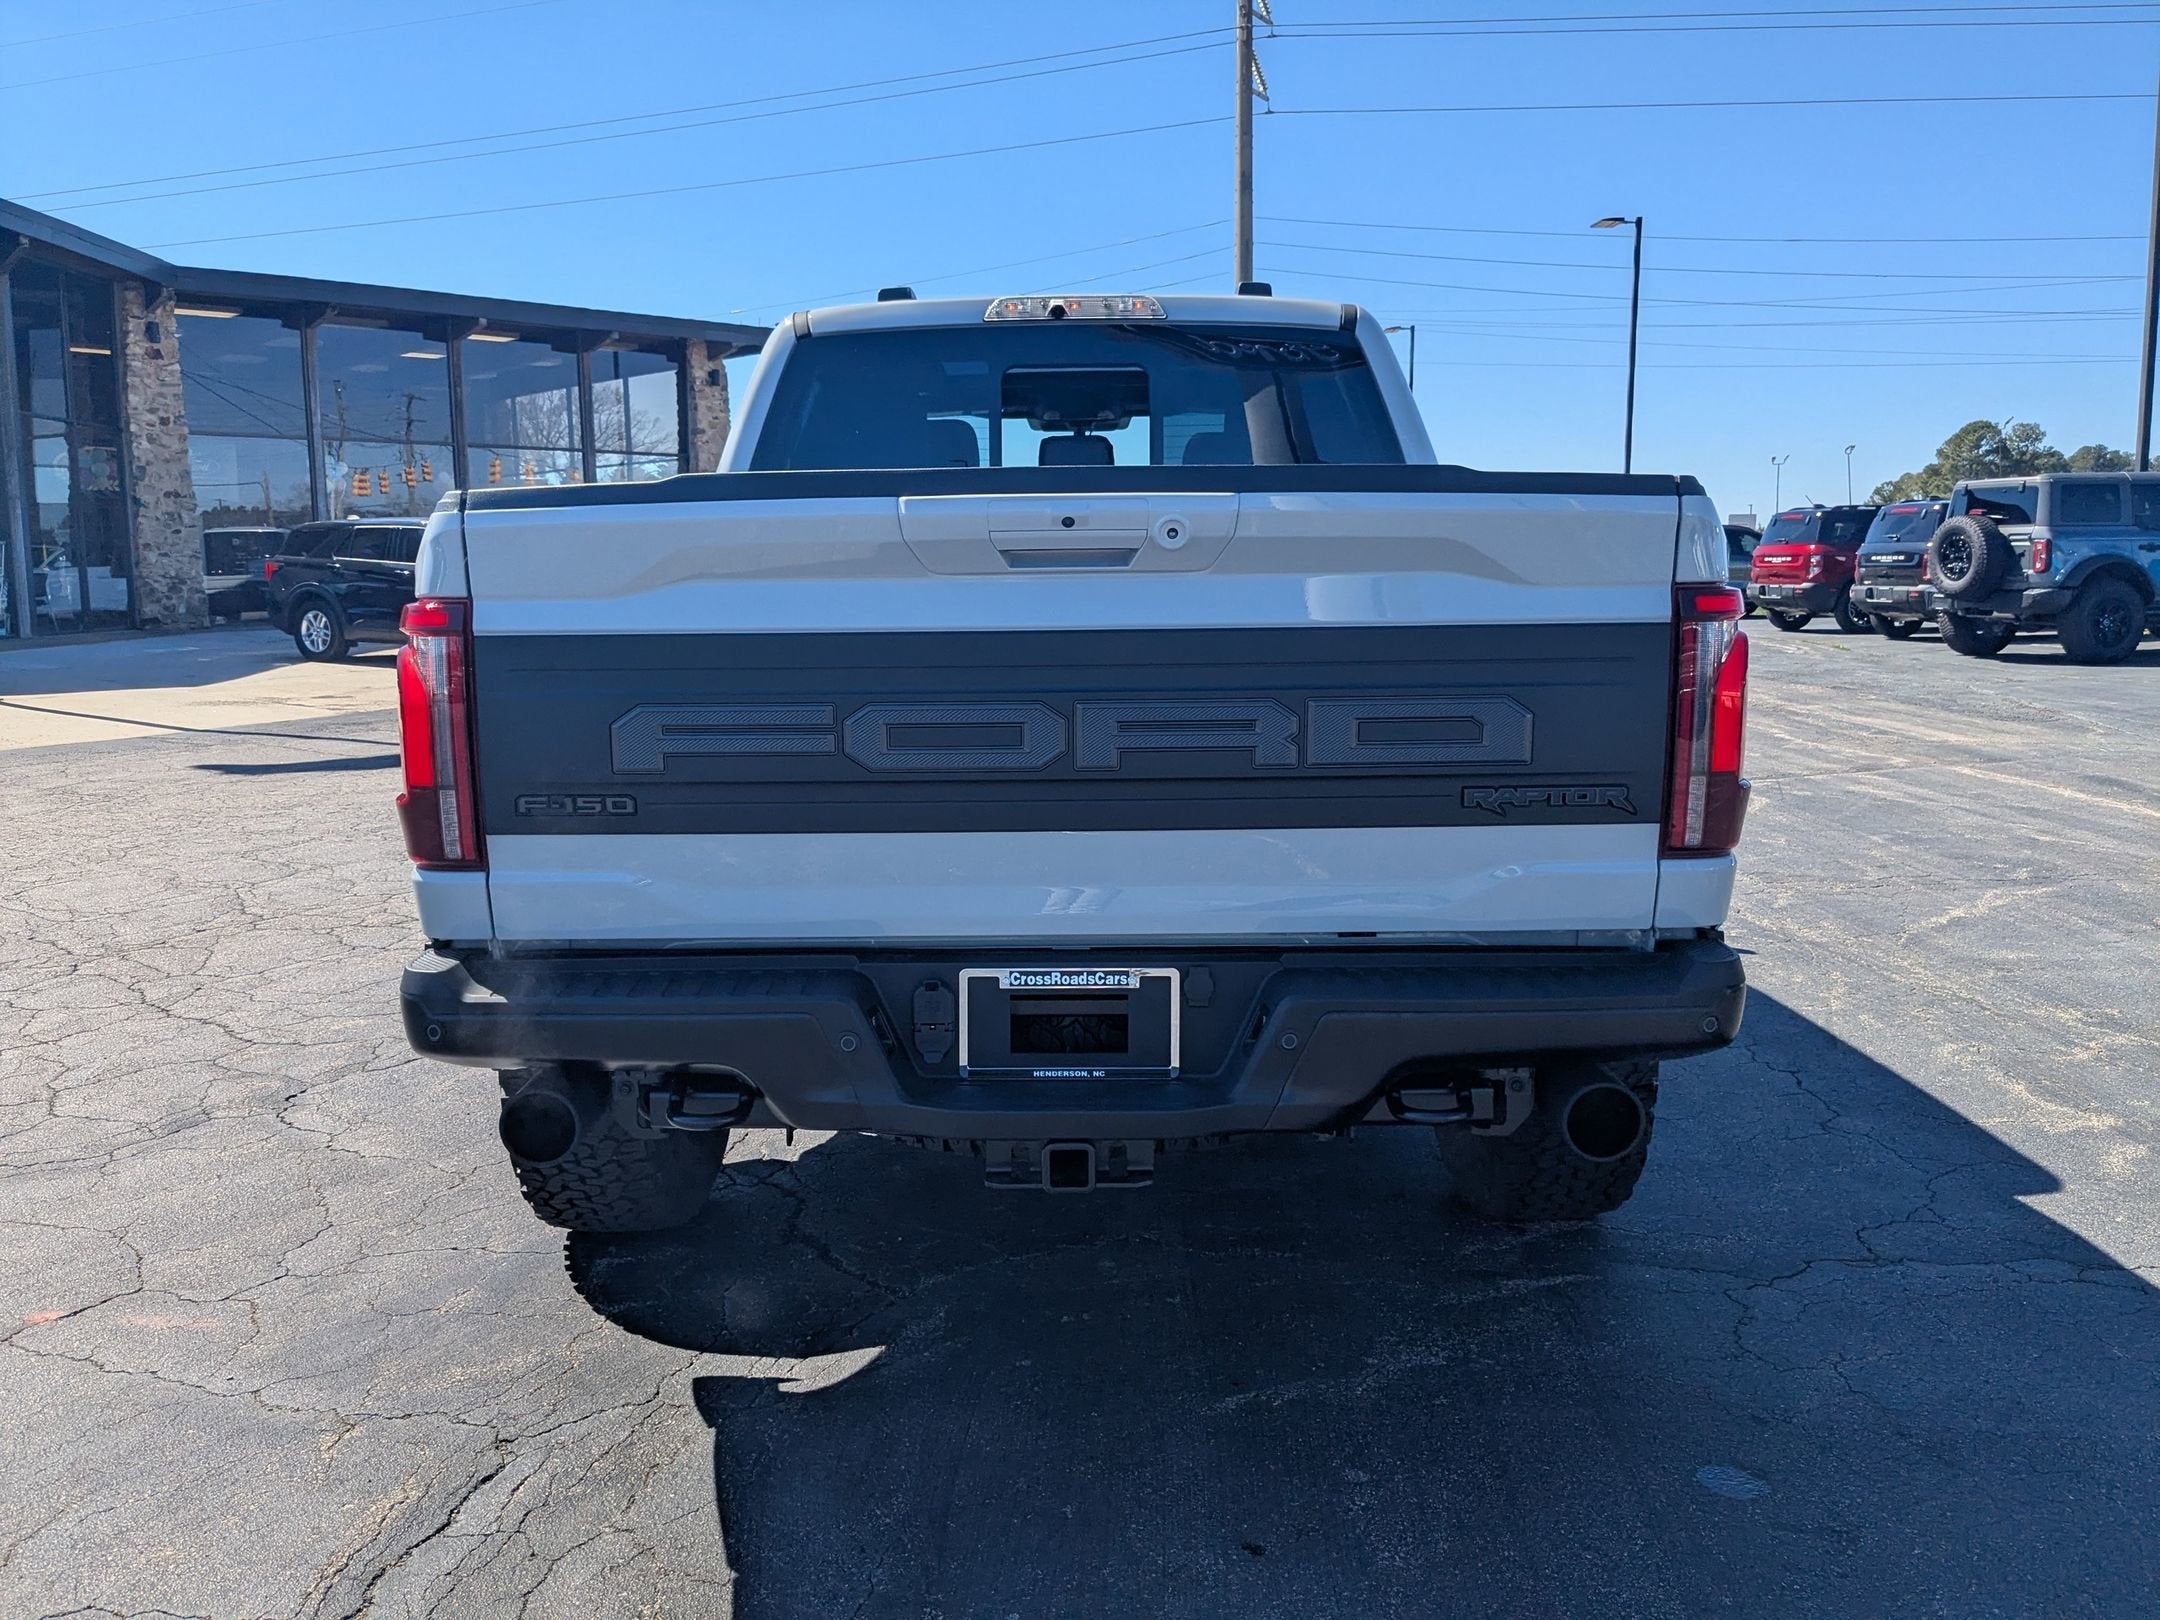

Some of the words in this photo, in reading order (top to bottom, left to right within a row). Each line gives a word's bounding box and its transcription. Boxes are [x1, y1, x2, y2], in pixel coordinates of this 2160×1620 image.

[610, 697, 1533, 774] FORD
[516, 794, 636, 816] F-150
[1462, 784, 1637, 816] RAPTOR
[1010, 972, 1128, 986] CrossRoadsCars
[1033, 1070, 1090, 1078] HENDERSON,
